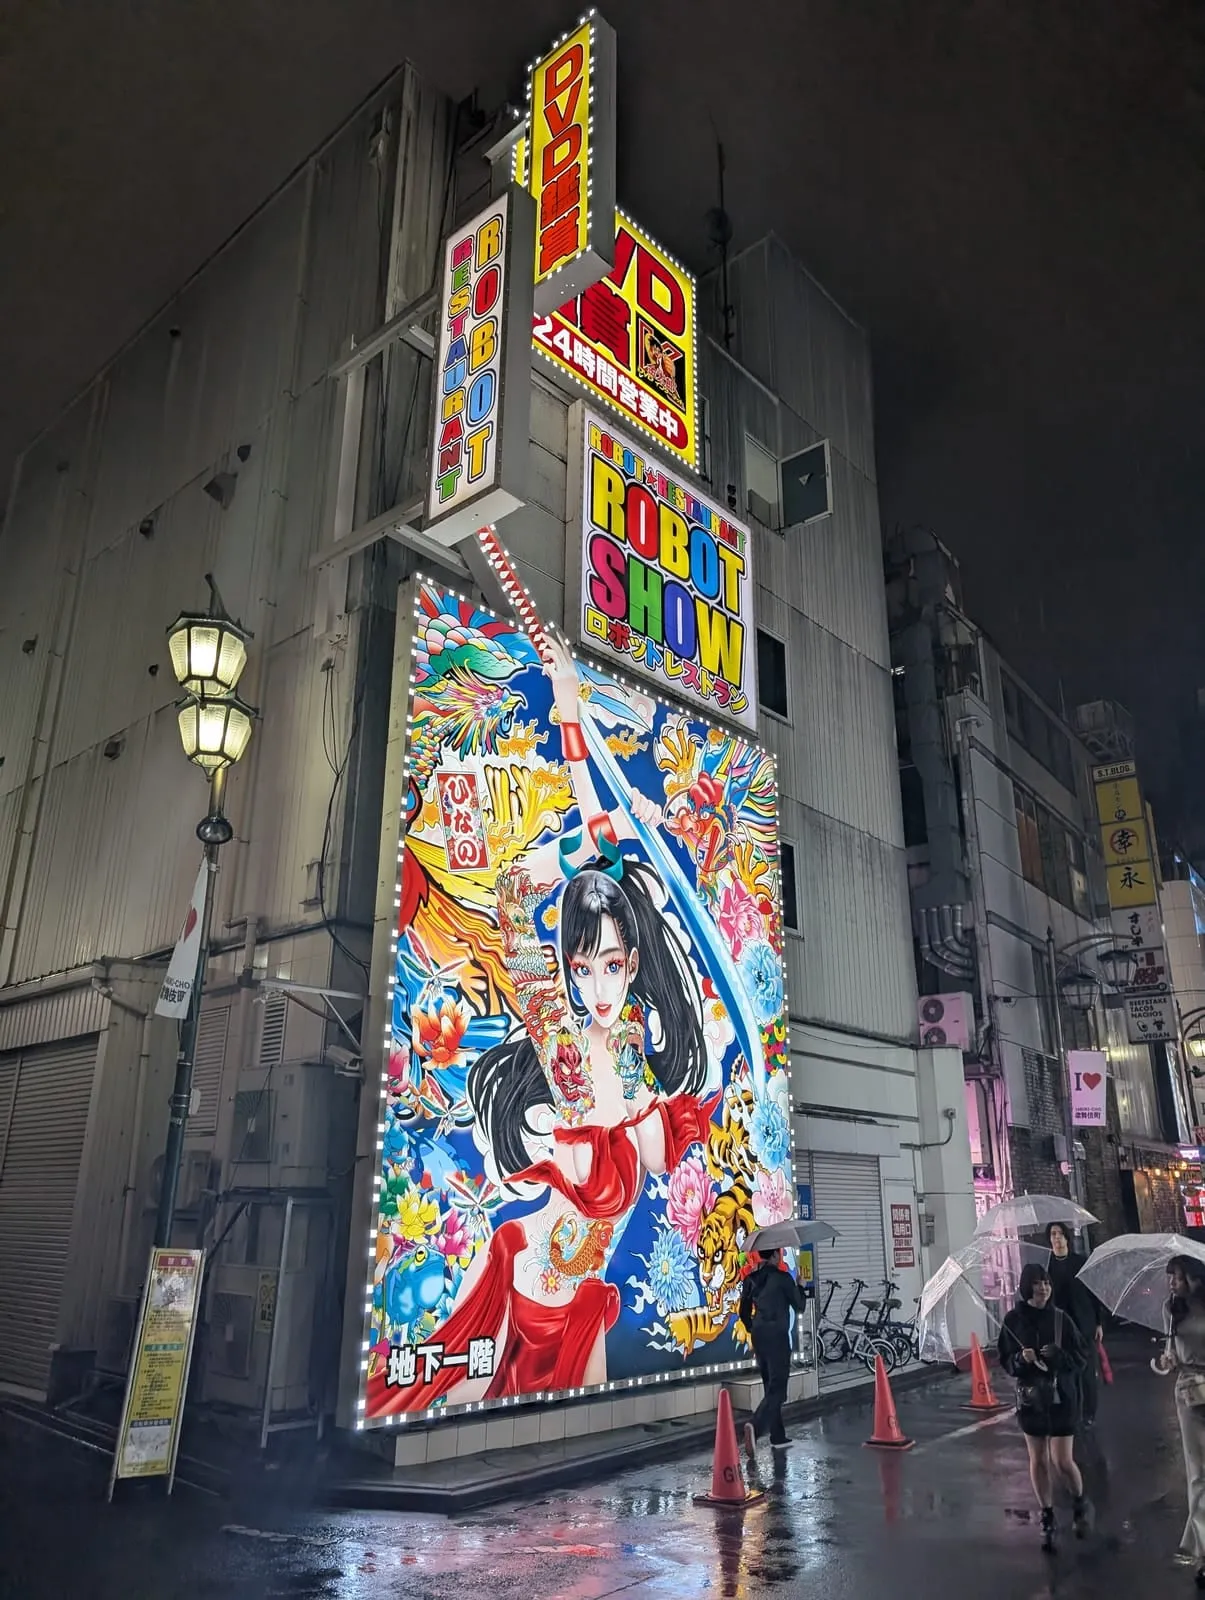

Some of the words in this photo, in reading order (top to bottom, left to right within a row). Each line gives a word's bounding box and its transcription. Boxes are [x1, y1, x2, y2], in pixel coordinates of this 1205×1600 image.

[539, 44, 584, 275] DVD鑑賞
[436, 238, 473, 502] RESTAURANT
[467, 216, 503, 482] ROBOT
[533, 313, 679, 439] 24時間営業中
[590, 423, 645, 481] ROBOT
[657, 472, 746, 553] RESTAURANT
[591, 456, 746, 616] ROBOT
[591, 536, 744, 688] SHOW
[448, 775, 481, 866] ひなの
[1113, 830, 1134, 854] 幸
[1120, 867, 1145, 889] 永
[1075, 1072, 1082, 1091] I
[387, 1338, 495, 1386] 地下一階
